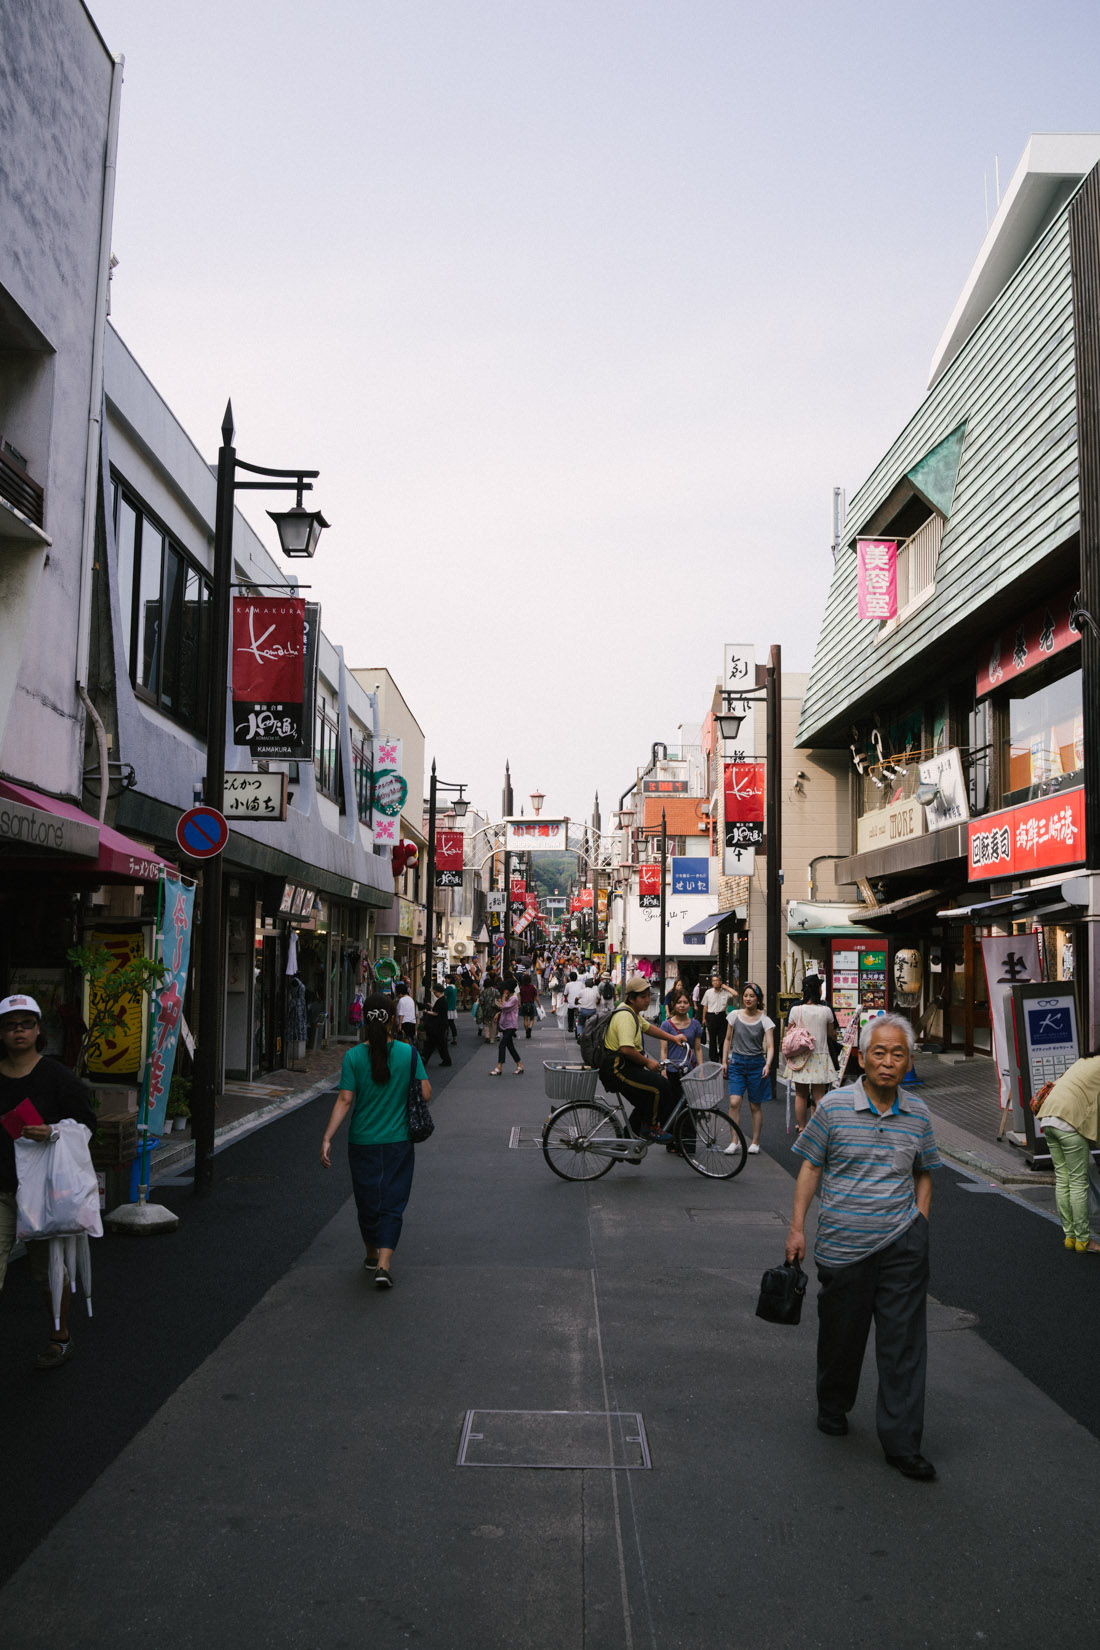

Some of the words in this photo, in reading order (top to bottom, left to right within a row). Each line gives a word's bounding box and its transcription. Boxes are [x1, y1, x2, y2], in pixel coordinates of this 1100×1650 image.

[865, 544, 890, 617] 美容室
[236, 607, 302, 615] KAMAKURA
[236, 605, 300, 664] Komachi
[0, 811, 64, 847] santoré
[513, 824, 560, 838] 小町通り
[971, 824, 1010, 868] 回転寿司
[1016, 805, 1078, 858] 海鮮三崎港
[675, 881, 707, 890] せいた
[102, 940, 131, 1068] ラメン
[1039, 1013, 1063, 1033] K
